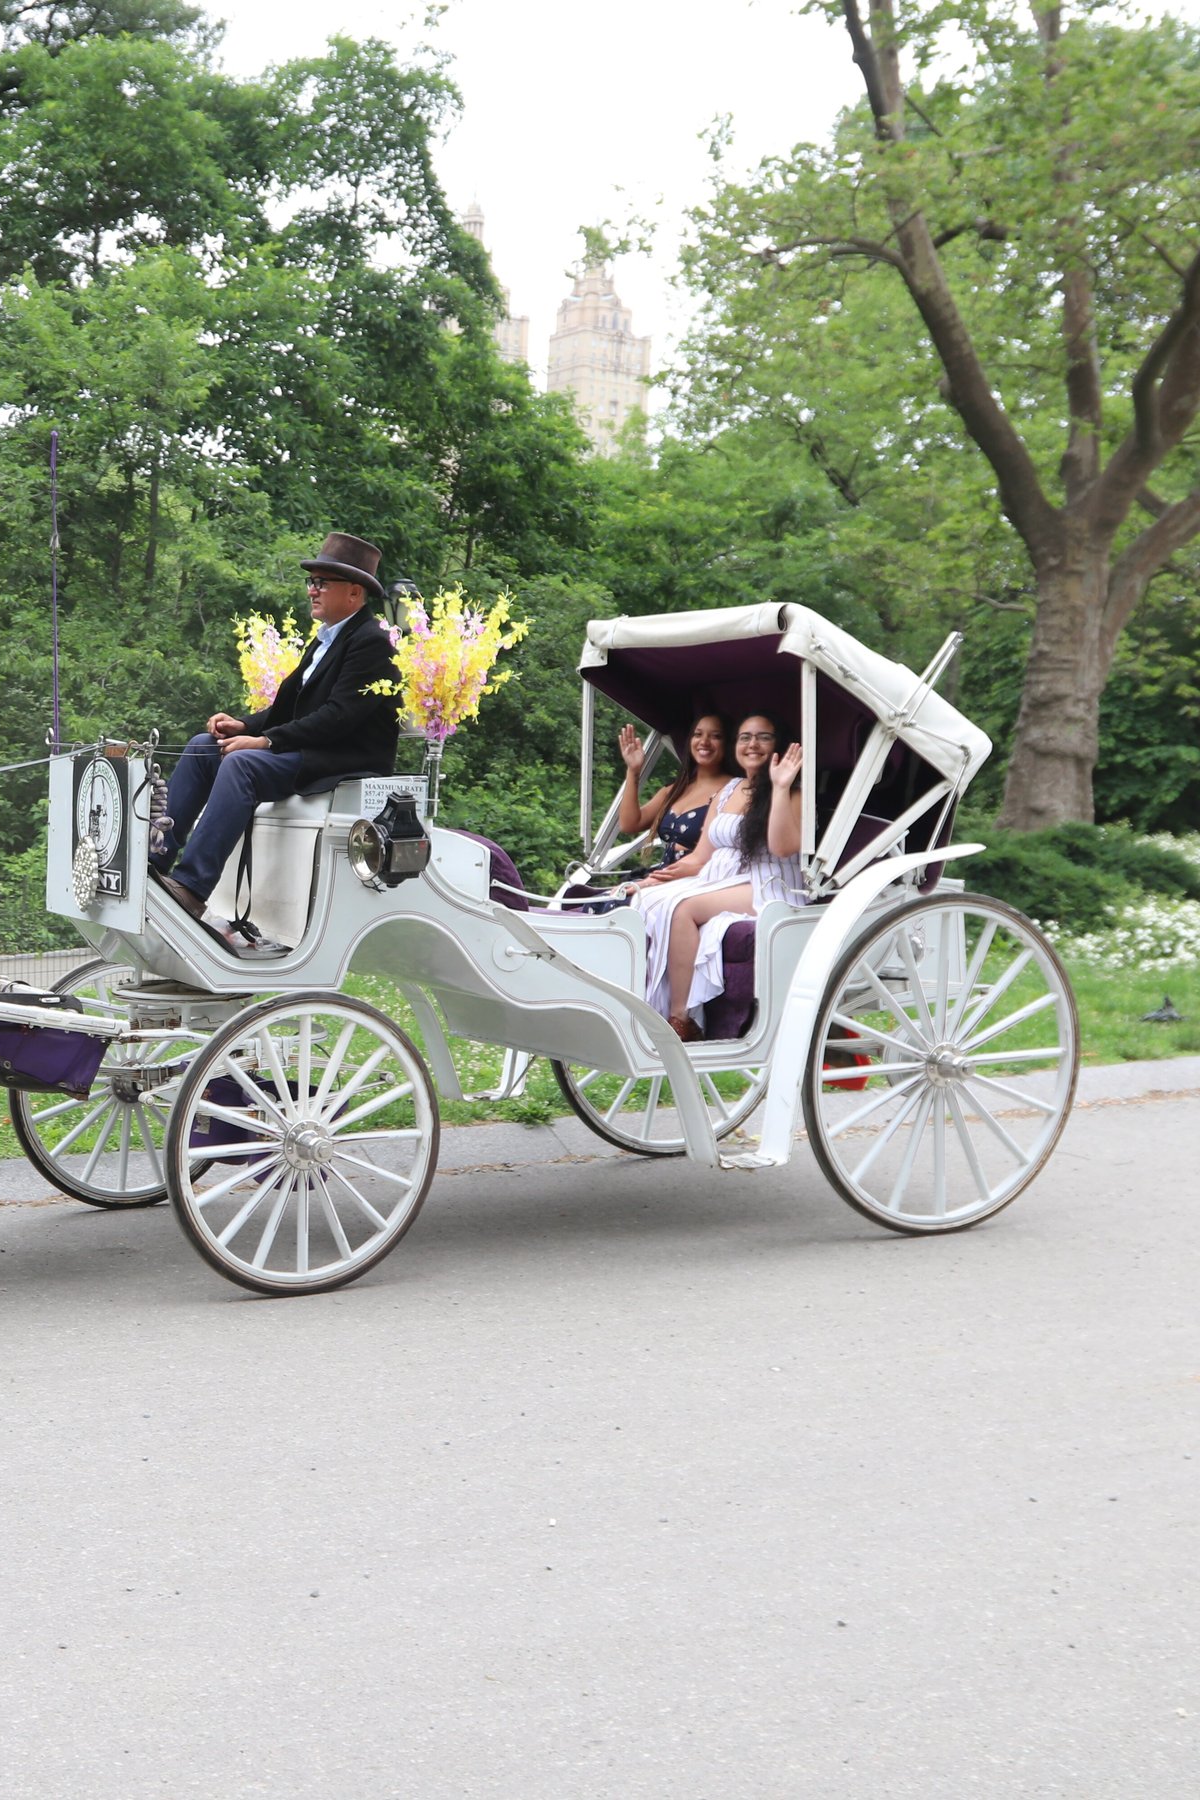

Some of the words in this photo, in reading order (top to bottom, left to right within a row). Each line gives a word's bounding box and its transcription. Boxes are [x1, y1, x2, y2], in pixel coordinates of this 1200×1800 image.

[81, 768, 94, 801] HORSE
[94, 765, 116, 792] CARRIAGE
[365, 783, 403, 792] MAXIMUM
